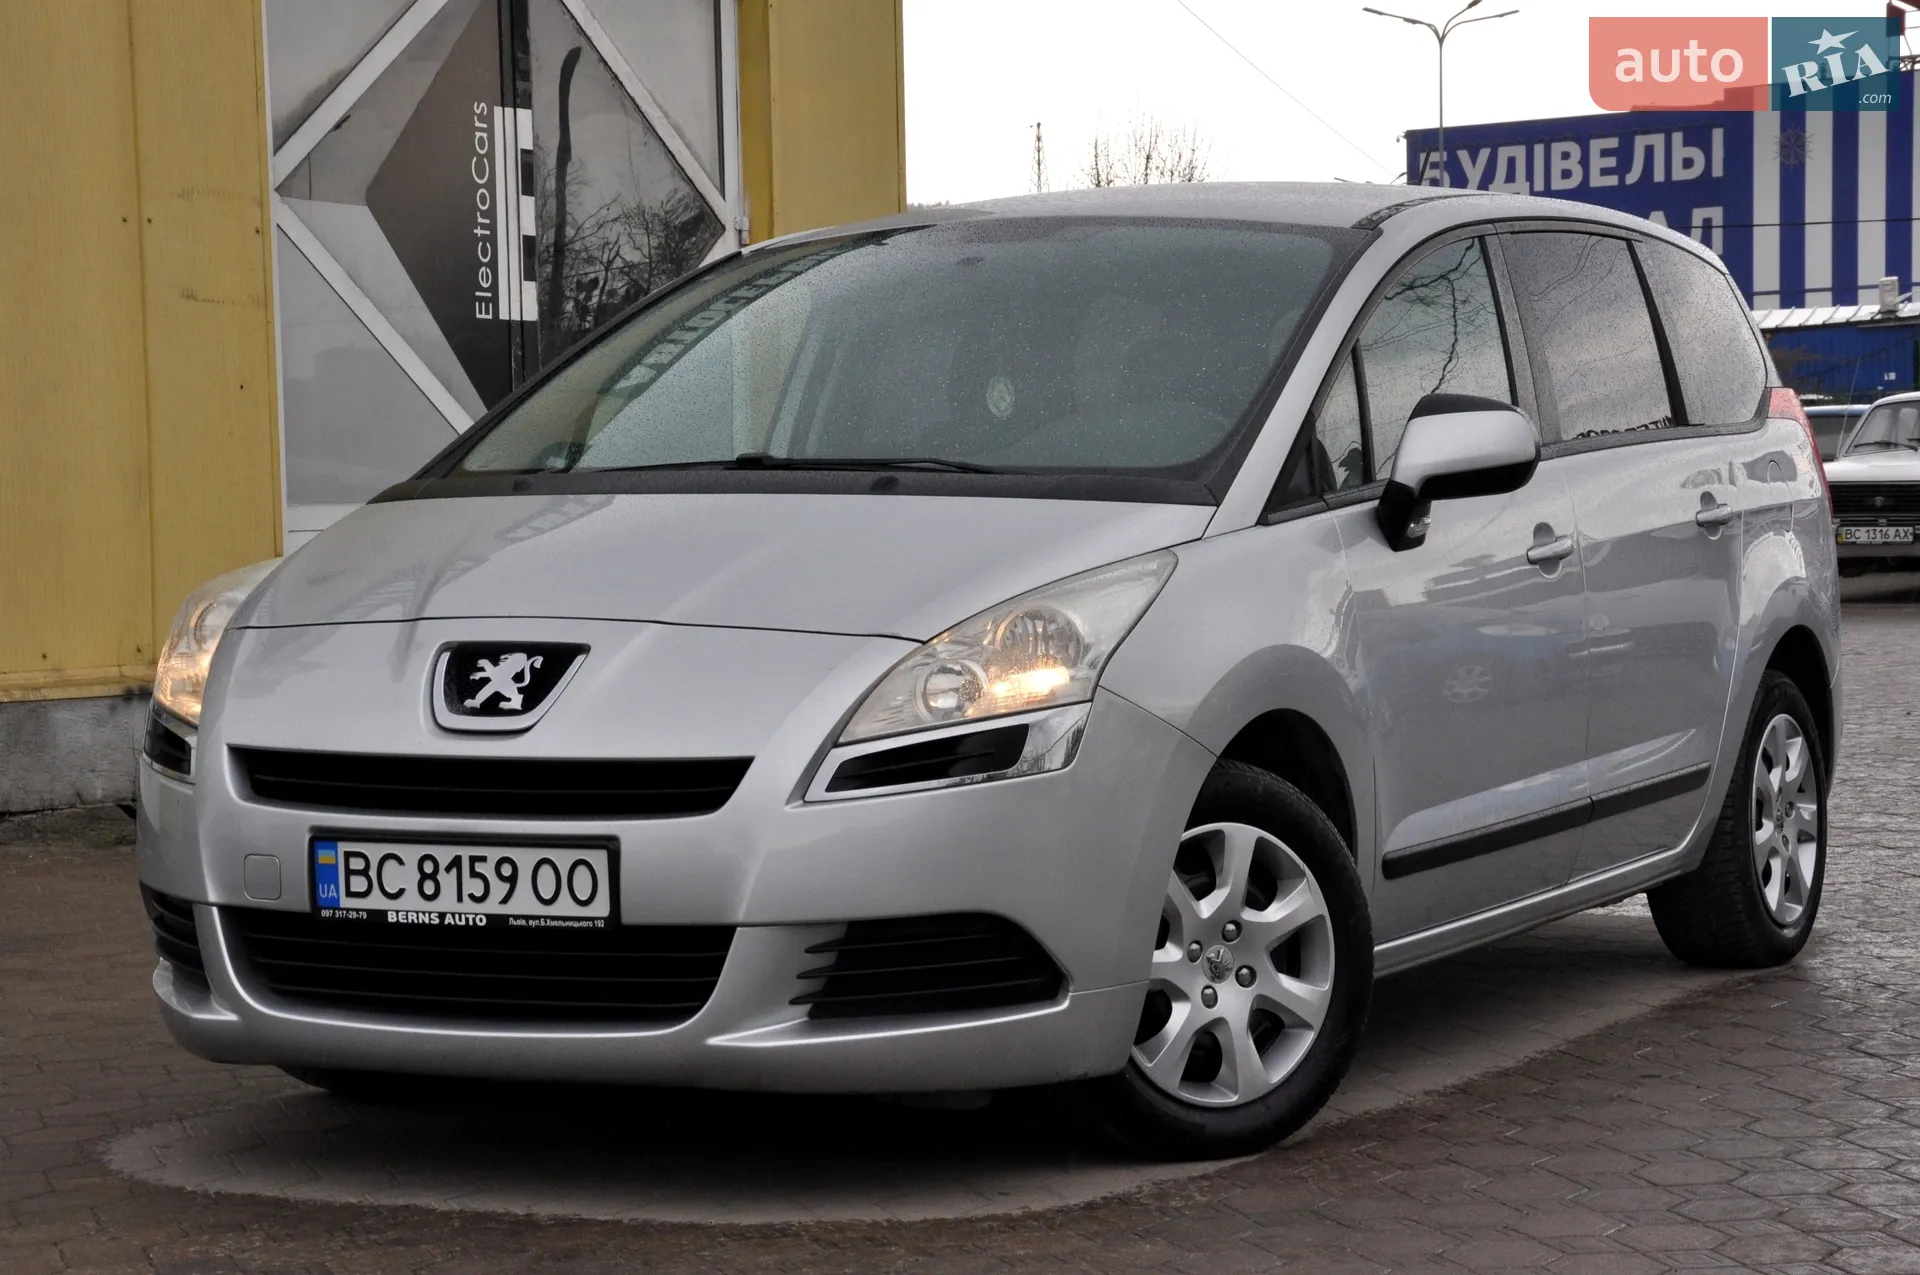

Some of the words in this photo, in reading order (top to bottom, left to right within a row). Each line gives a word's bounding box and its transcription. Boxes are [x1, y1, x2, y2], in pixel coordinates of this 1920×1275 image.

[471, 101, 493, 320] ElectroCars
[1844, 528, 1862, 540] BC
[1865, 528, 1891, 540] 1316
[1893, 528, 1911, 540] AX
[343, 850, 407, 901] BC
[417, 853, 520, 905] 8159
[318, 883, 338, 899] UA
[321, 909, 333, 918] 097
[387, 911, 440, 924] BERNS
[444, 913, 487, 926] AUTO
